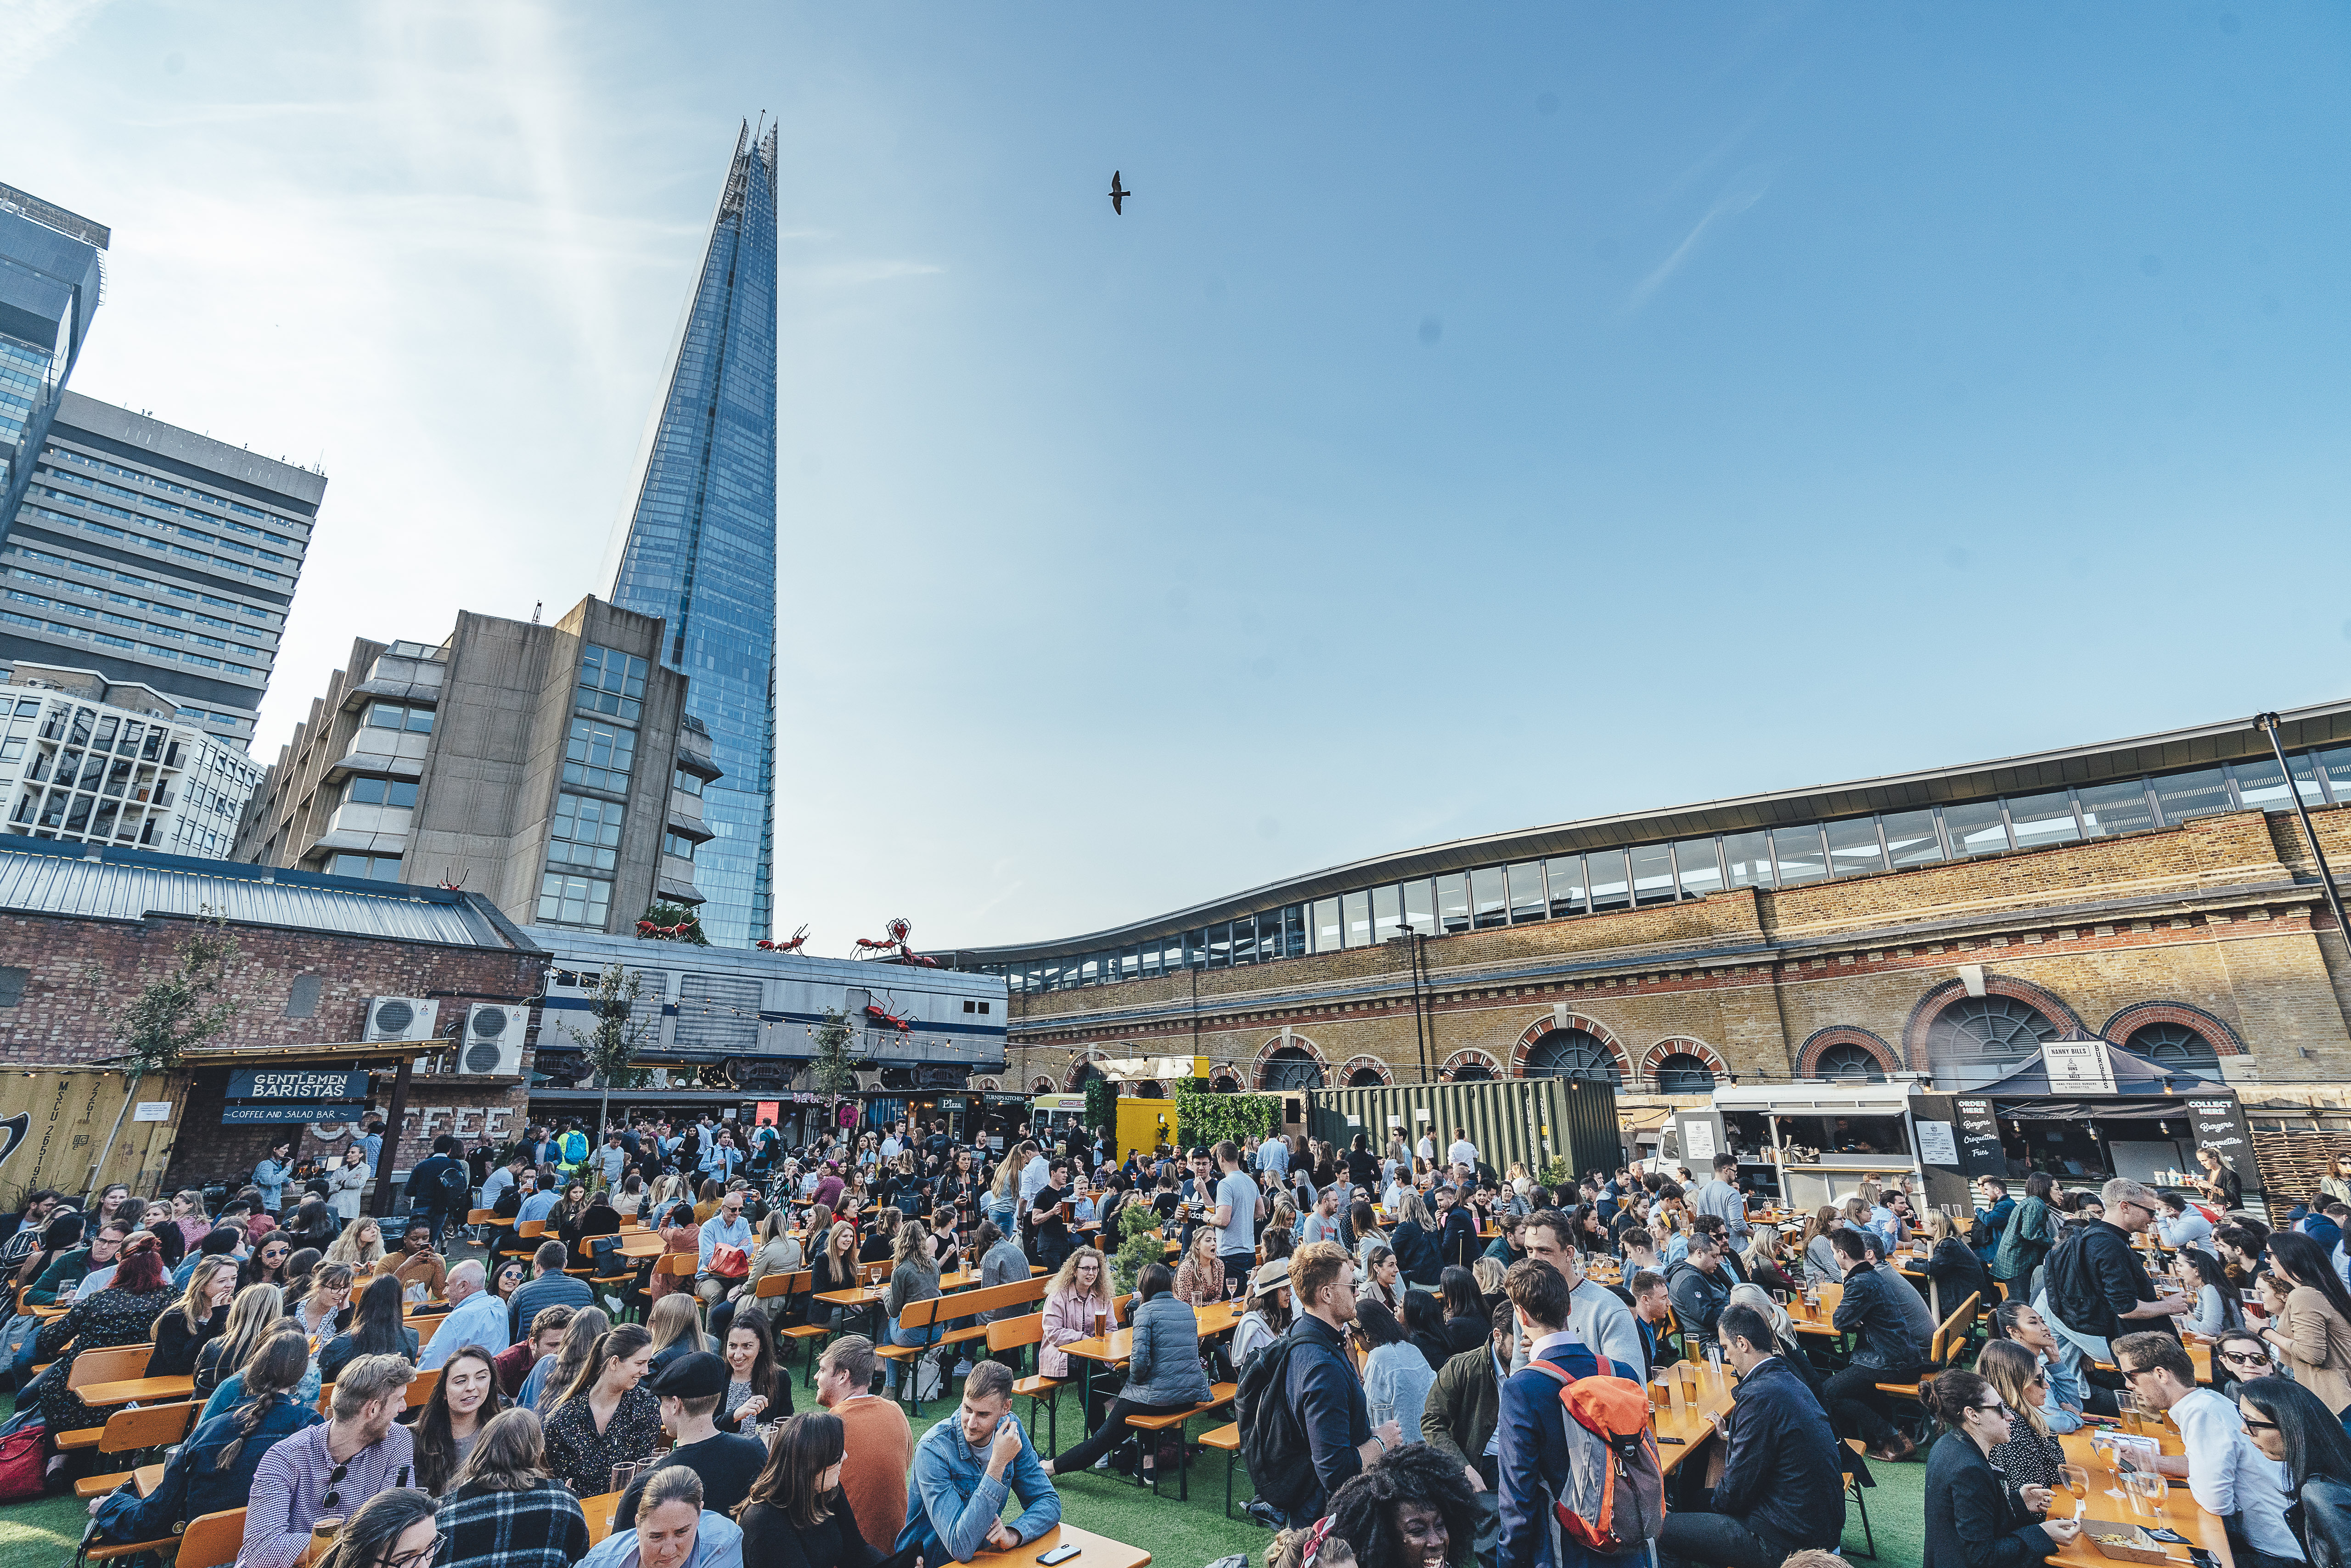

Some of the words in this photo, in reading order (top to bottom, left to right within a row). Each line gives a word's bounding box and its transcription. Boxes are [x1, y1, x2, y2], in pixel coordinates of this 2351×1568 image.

[2094, 1045, 2109, 1089] BURGERS
[254, 1074, 348, 1085] GENTLEMEN
[252, 1085, 345, 1096] BARISTAS
[51, 1081, 69, 1121] MSCU
[87, 1082, 101, 1121] 22G1
[942, 1099, 963, 1108] Pizza
[316, 1110, 335, 1118] BAR
[1963, 1120, 1991, 1130] Burgers
[2199, 1121, 2234, 1133] Burgers
[1964, 1133, 1997, 1144] Croquettes
[2201, 1137, 2243, 1148] Croquettes
[30, 1125, 54, 1186] 265196
[1971, 1148, 1989, 1157] Fries
[1187, 1211, 1204, 1220] idas
